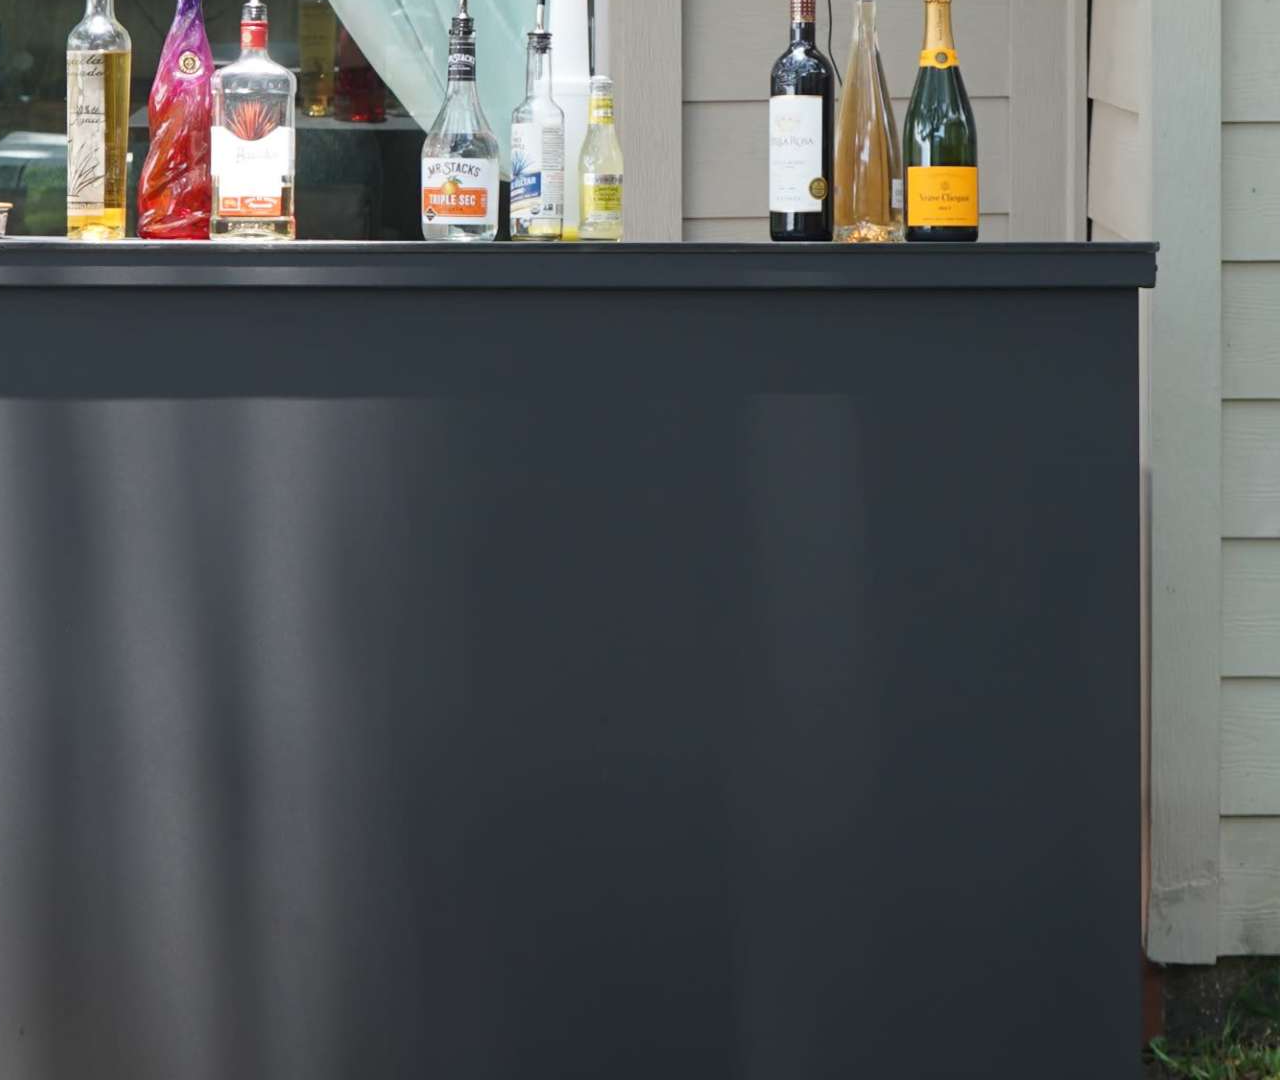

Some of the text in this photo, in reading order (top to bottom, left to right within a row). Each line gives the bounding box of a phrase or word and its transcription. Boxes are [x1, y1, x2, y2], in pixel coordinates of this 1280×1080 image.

[442, 161, 481, 178] STACKS
[429, 193, 457, 207] TRIPLE
[458, 194, 477, 207] SEC
